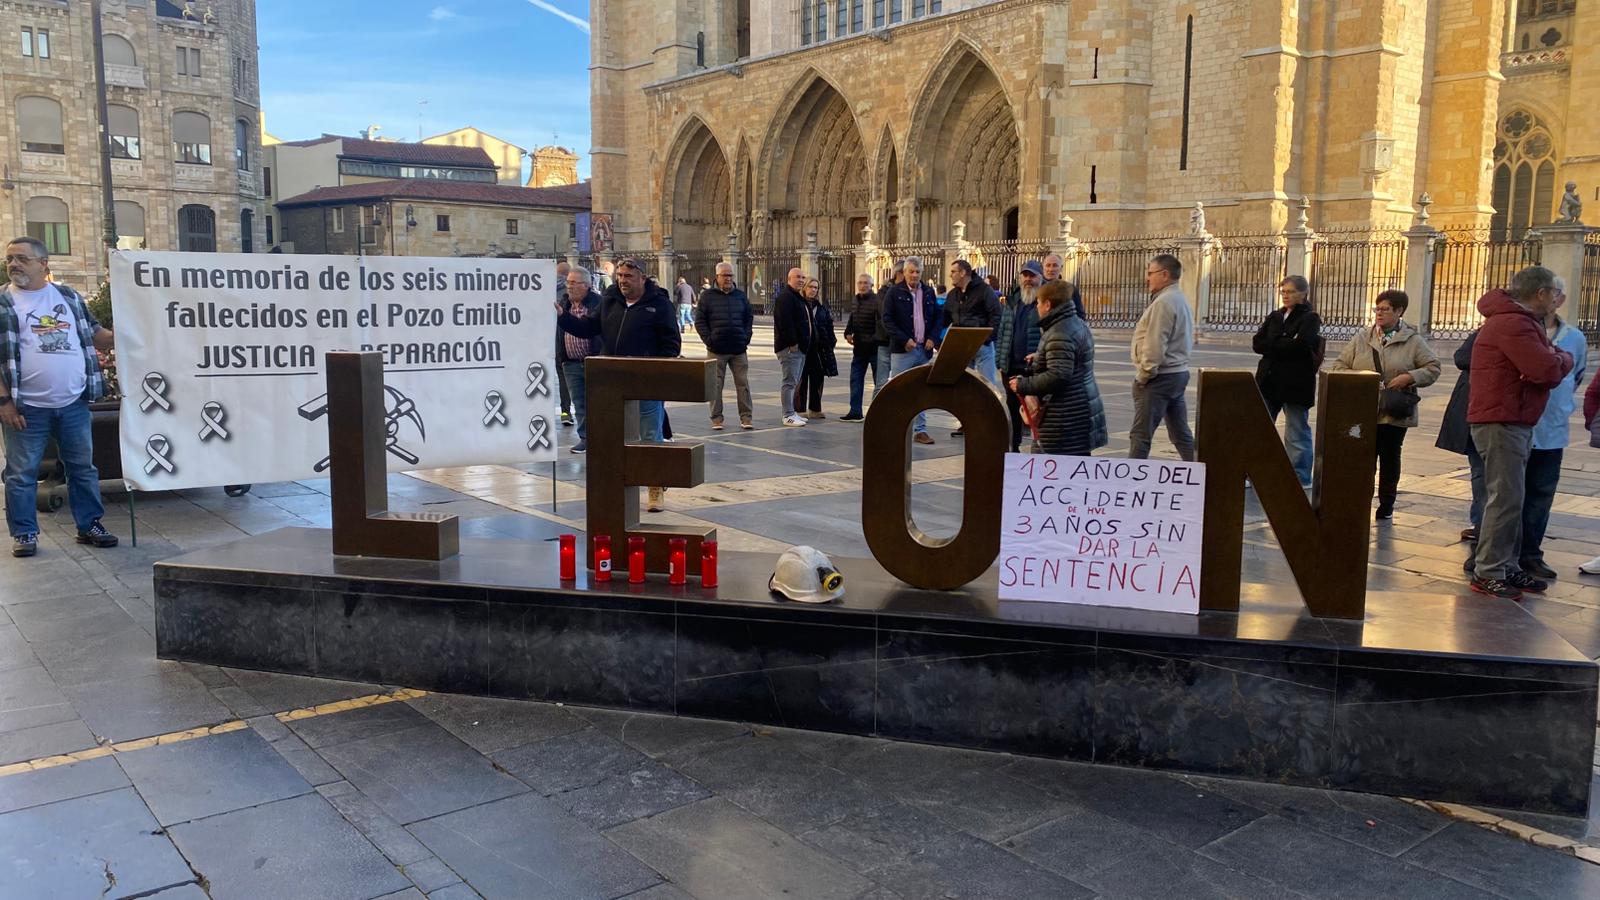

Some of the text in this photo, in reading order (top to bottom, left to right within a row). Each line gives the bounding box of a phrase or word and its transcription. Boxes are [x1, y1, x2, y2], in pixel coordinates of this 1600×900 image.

[134, 261, 542, 291] En memoria de los seis mineros
[165, 302, 521, 328] fallecidos en el Pozo Emilio
[196, 345, 315, 369] JUSTICIA
[326, 327, 1379, 620] LEÓN
[1020, 458, 1200, 486] 12 AÑOS DEL
[1079, 536, 1160, 559] DAR LA
